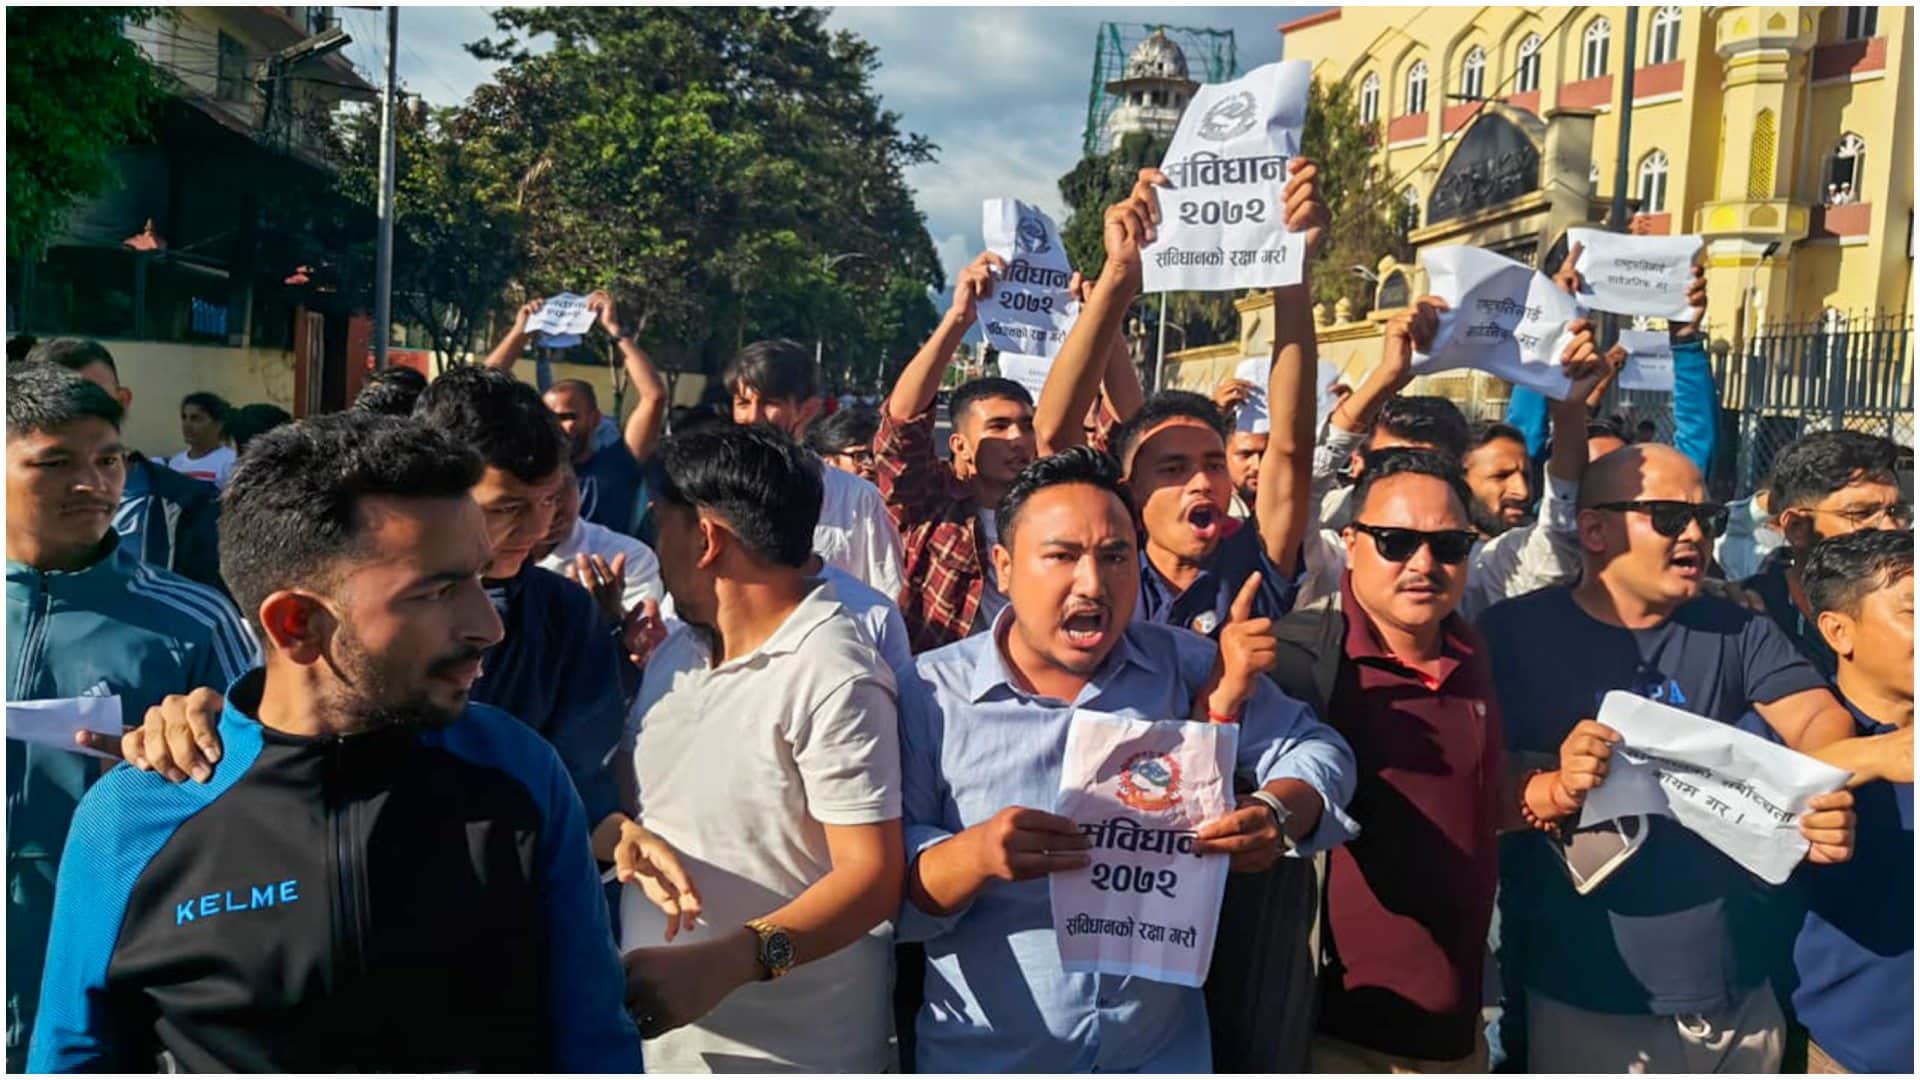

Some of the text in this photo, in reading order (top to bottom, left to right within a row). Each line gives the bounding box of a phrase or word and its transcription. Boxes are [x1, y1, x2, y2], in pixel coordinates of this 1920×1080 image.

[1179, 198, 1266, 225] २०७२
[1229, 250, 1258, 267] रक्षा
[1000, 290, 1054, 315] २०७२
[1091, 863, 1178, 898] २०७२
[176, 880, 299, 926] KELME
[1139, 922, 1166, 942] रक्षा
